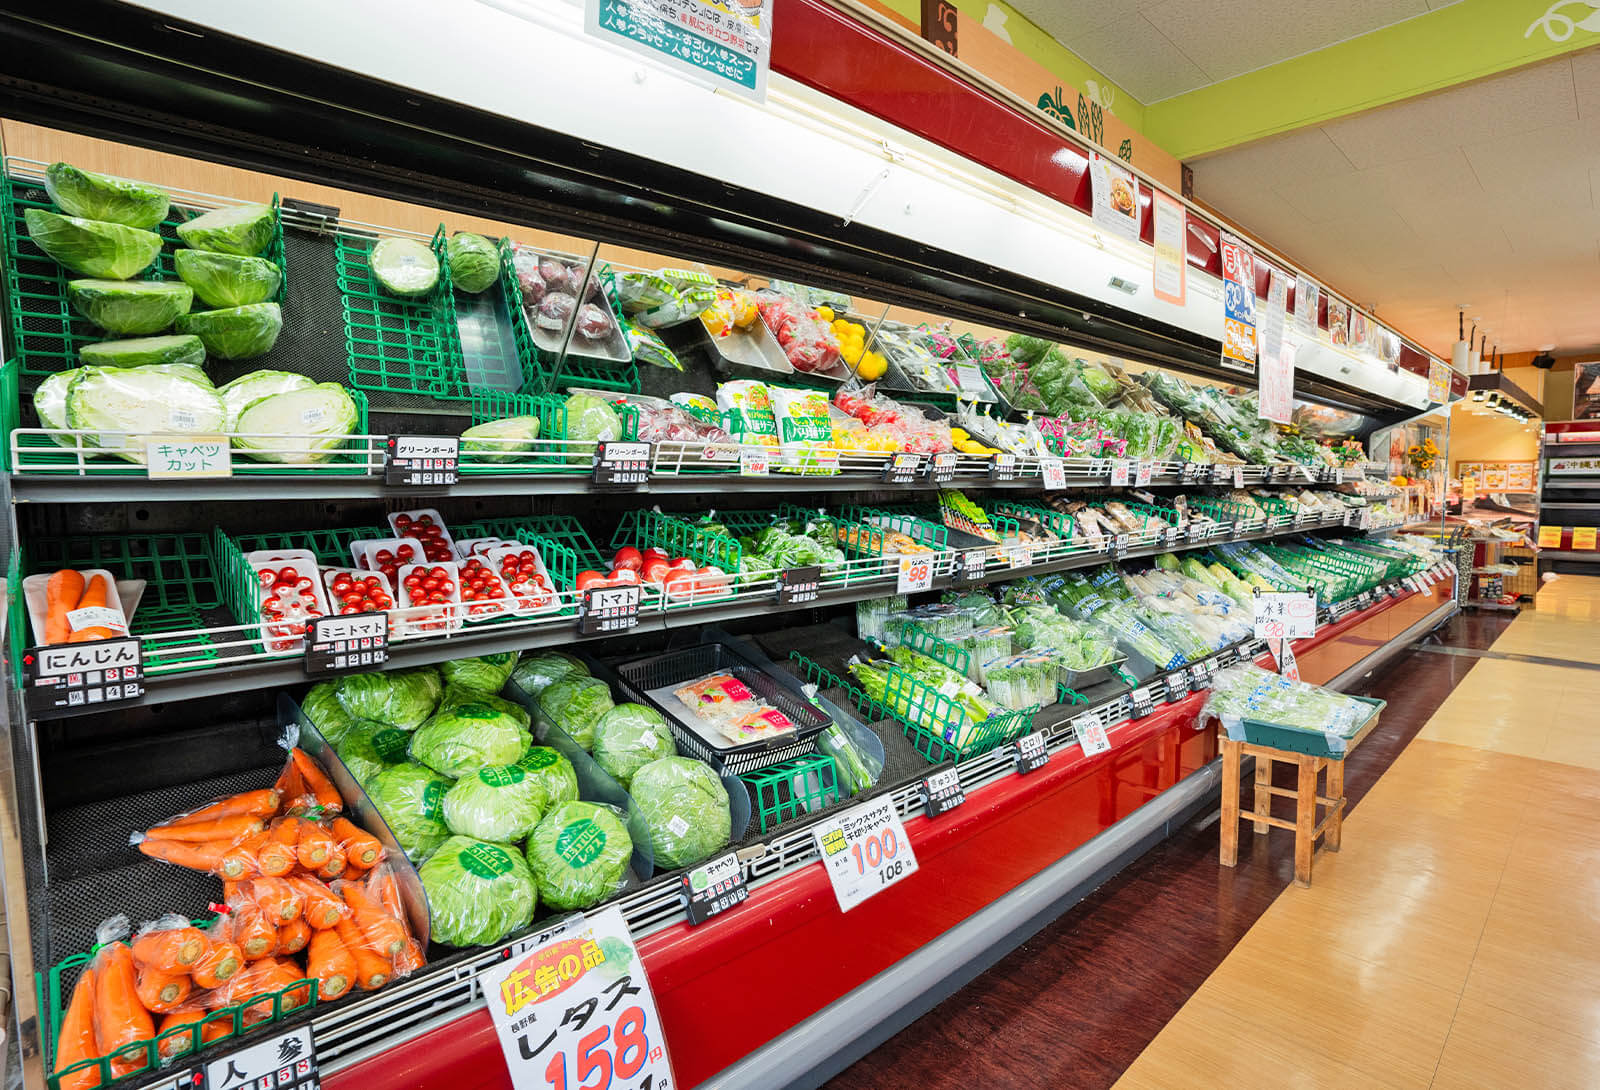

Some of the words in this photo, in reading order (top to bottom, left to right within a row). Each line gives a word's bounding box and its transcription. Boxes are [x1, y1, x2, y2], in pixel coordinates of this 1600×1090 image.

[158, 445, 220, 457] キャベツ
[400, 446, 455, 454] グリーンボール
[168, 459, 212, 471] カット
[909, 565, 928, 582] 98
[601, 591, 633, 607] トマト
[322, 622, 382, 638] ミニトマト
[47, 647, 134, 670] にんじん
[106, 665, 136, 681] 38
[108, 684, 136, 697] 42
[843, 805, 889, 832] ミックスサラダ
[562, 822, 601, 862] LETTUCE
[577, 836, 604, 864] レタス
[851, 827, 897, 875] 100
[707, 856, 734, 875] キャベツ
[879, 860, 903, 884] 108
[500, 939, 606, 1016] 広告の品
[511, 1013, 537, 1034] 長野産
[517, 975, 642, 1061] レタス
[221, 1037, 303, 1088] 人参
